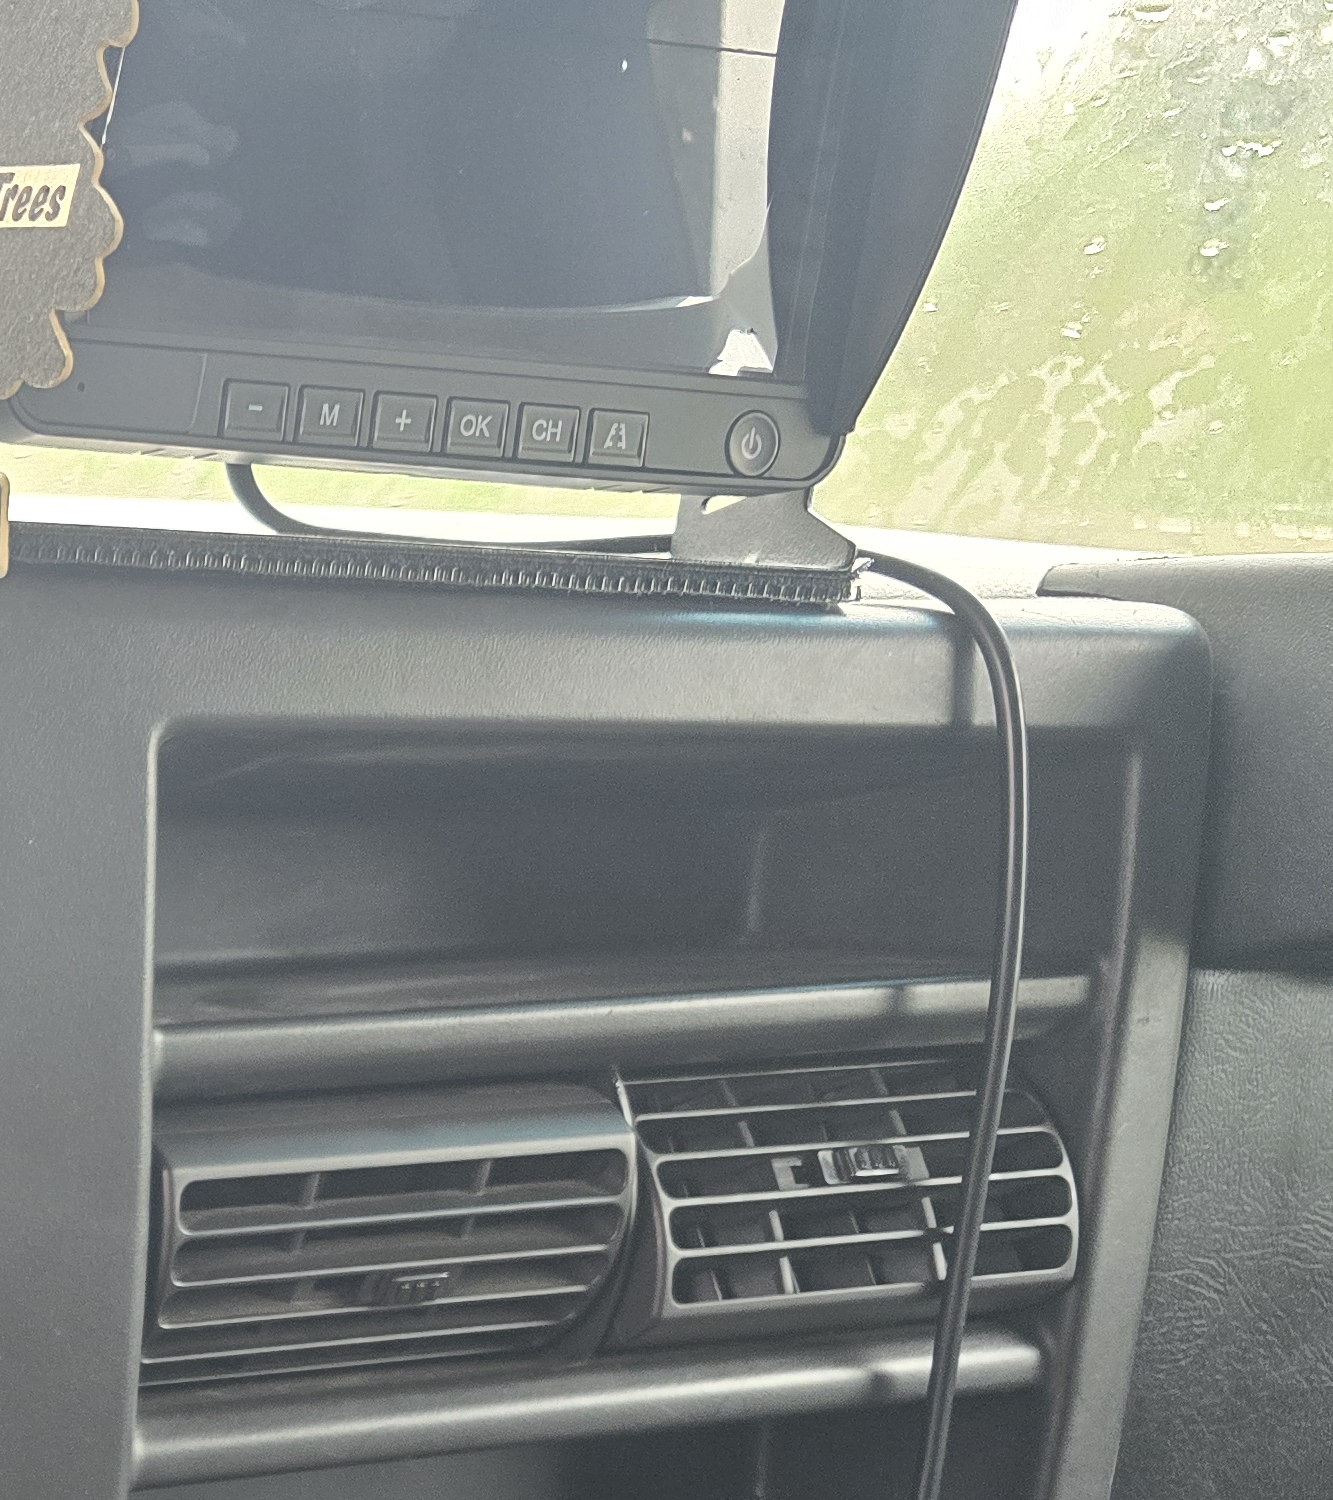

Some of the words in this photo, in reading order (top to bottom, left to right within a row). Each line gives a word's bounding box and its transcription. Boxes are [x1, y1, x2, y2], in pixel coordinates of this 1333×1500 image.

[319, 402, 340, 427] M
[459, 414, 493, 438] OK
[532, 419, 563, 443] CH
